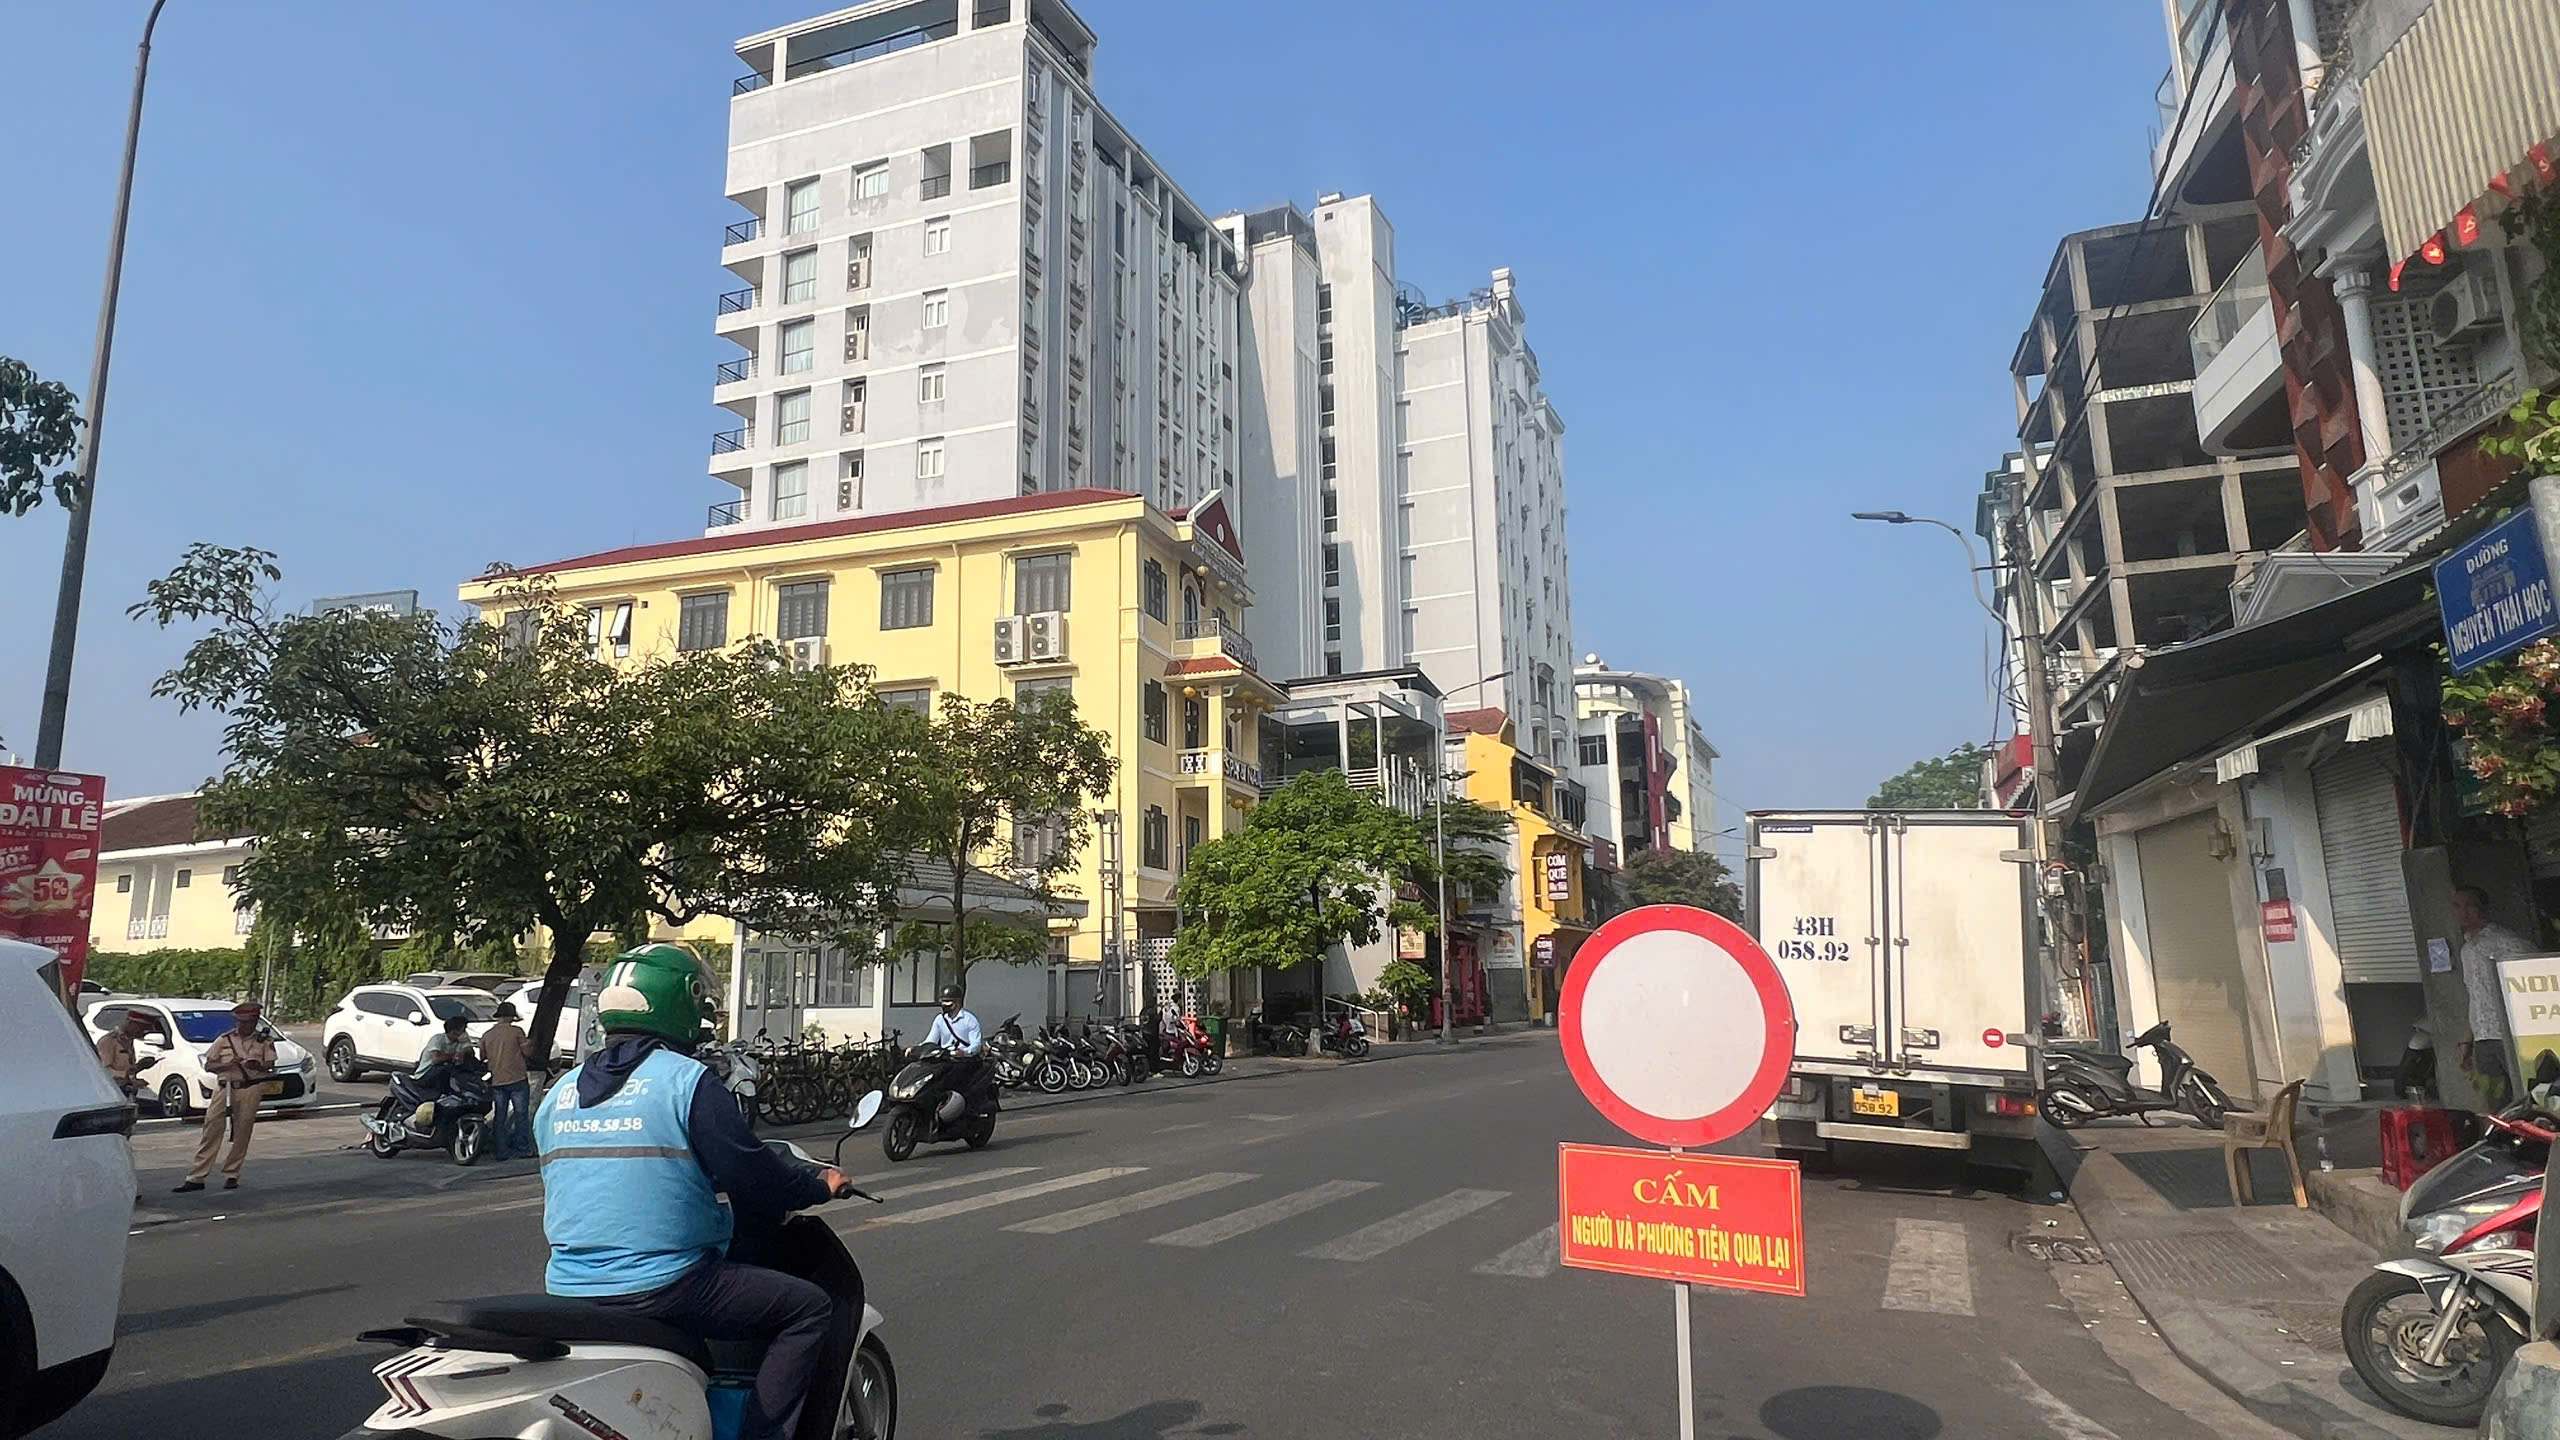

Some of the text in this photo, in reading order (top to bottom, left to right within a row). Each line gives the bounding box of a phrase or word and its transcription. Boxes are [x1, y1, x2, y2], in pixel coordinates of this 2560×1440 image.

[2522, 577, 2552, 625] HỌC
[13, 783, 84, 805] MỪNG
[60, 800, 99, 831] LỄ
[1793, 916, 1835, 937] 43H
[1778, 940, 1850, 962] 058.92
[1633, 1169, 1721, 1211] CẤM
[1572, 1210, 1791, 1276] NGƯỜI VÀ PHƯƠNG TIỆN QUA LẠI
